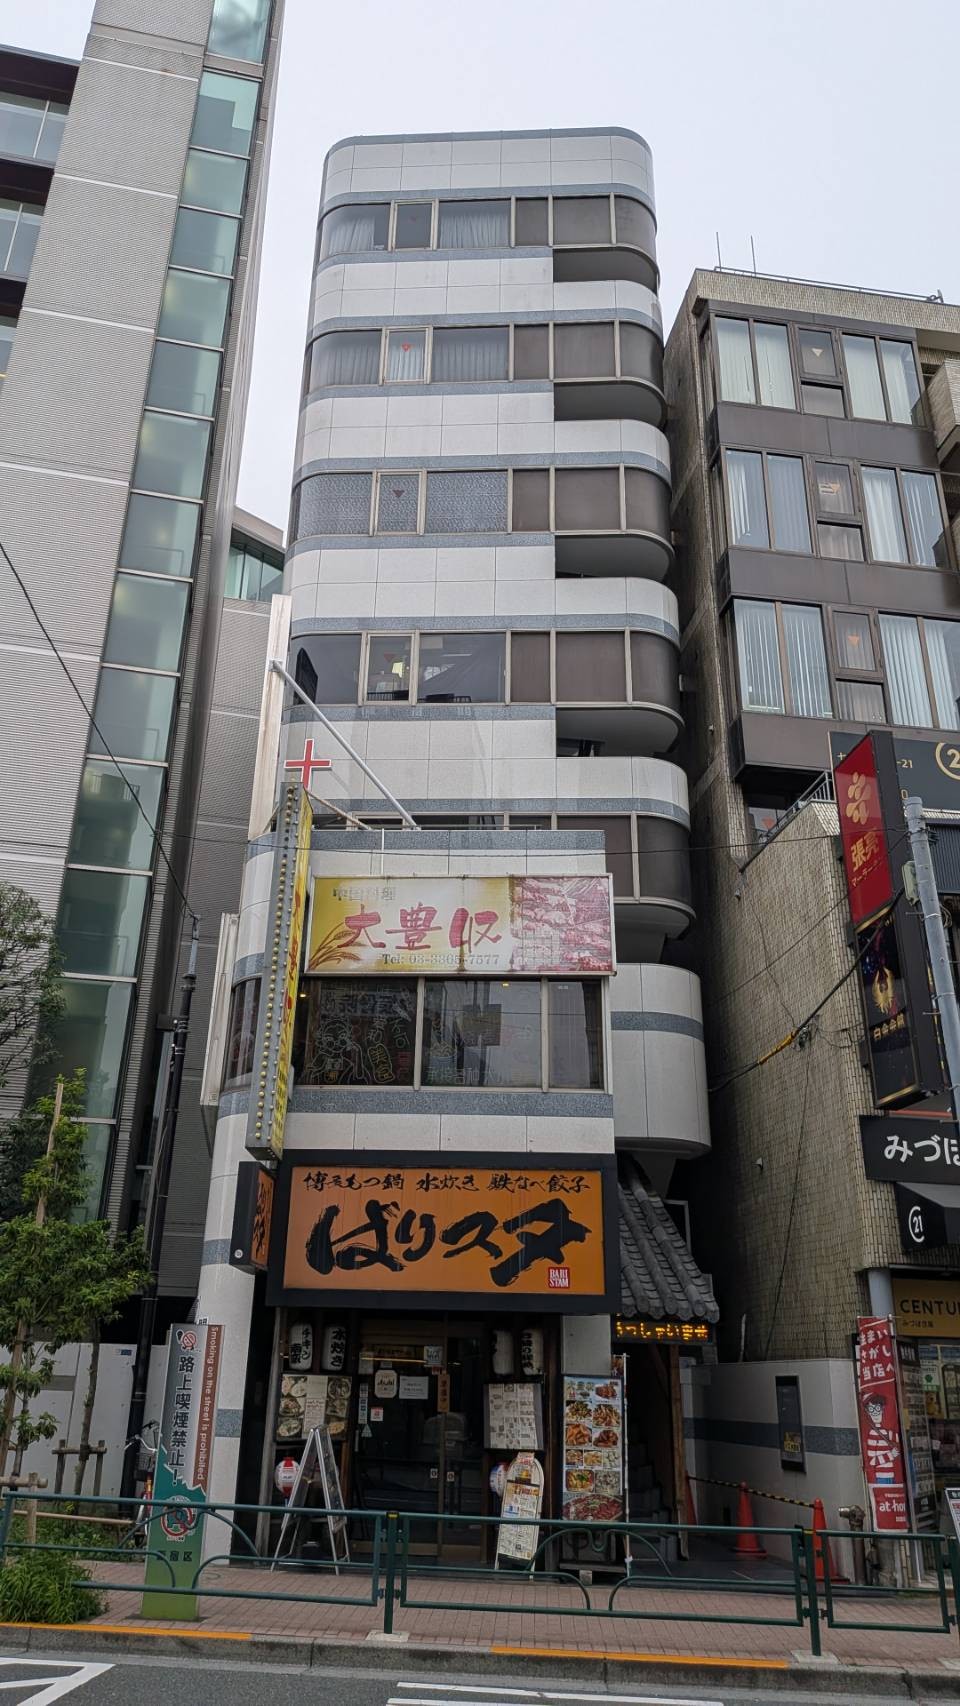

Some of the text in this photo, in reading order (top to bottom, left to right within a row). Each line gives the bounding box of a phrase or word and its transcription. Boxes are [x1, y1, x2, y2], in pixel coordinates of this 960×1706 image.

[337, 901, 502, 953] 大豊収
[382, 954, 404, 965] Tel:
[303, 1172, 591, 1194] 博多もつ鍋 水炊き 鉄なべ餃子
[207, 1327, 219, 1365] Smoking
[301, 1328, 311, 1360] チキン
[330, 1328, 345, 1367] 水炊き
[207, 1367, 214, 1378] on
[862, 1363, 895, 1380] 当店へ
[205, 1379, 213, 1394] the
[203, 1396, 212, 1422] street
[197, 1432, 207, 1480] prohibited
